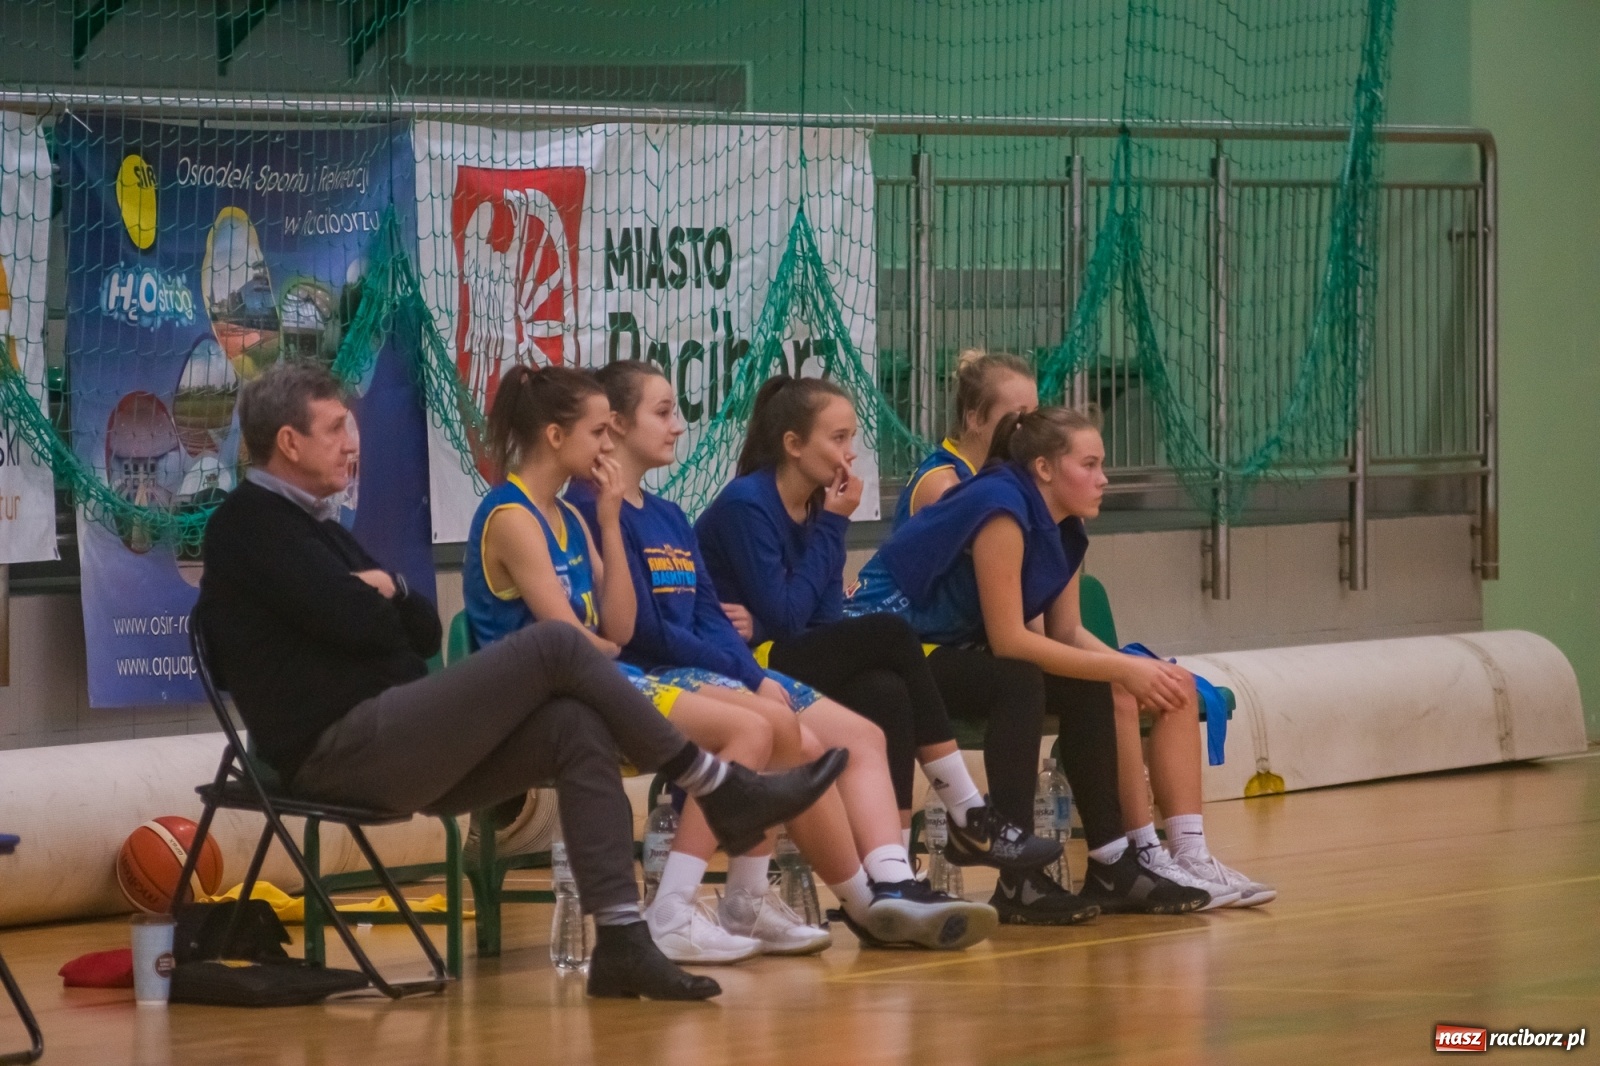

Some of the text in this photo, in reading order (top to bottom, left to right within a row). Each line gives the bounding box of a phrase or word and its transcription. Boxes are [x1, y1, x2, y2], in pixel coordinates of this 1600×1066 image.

[256, 164, 309, 196] Sportu
[285, 217, 298, 235] w
[605, 226, 733, 290] MIASTO
